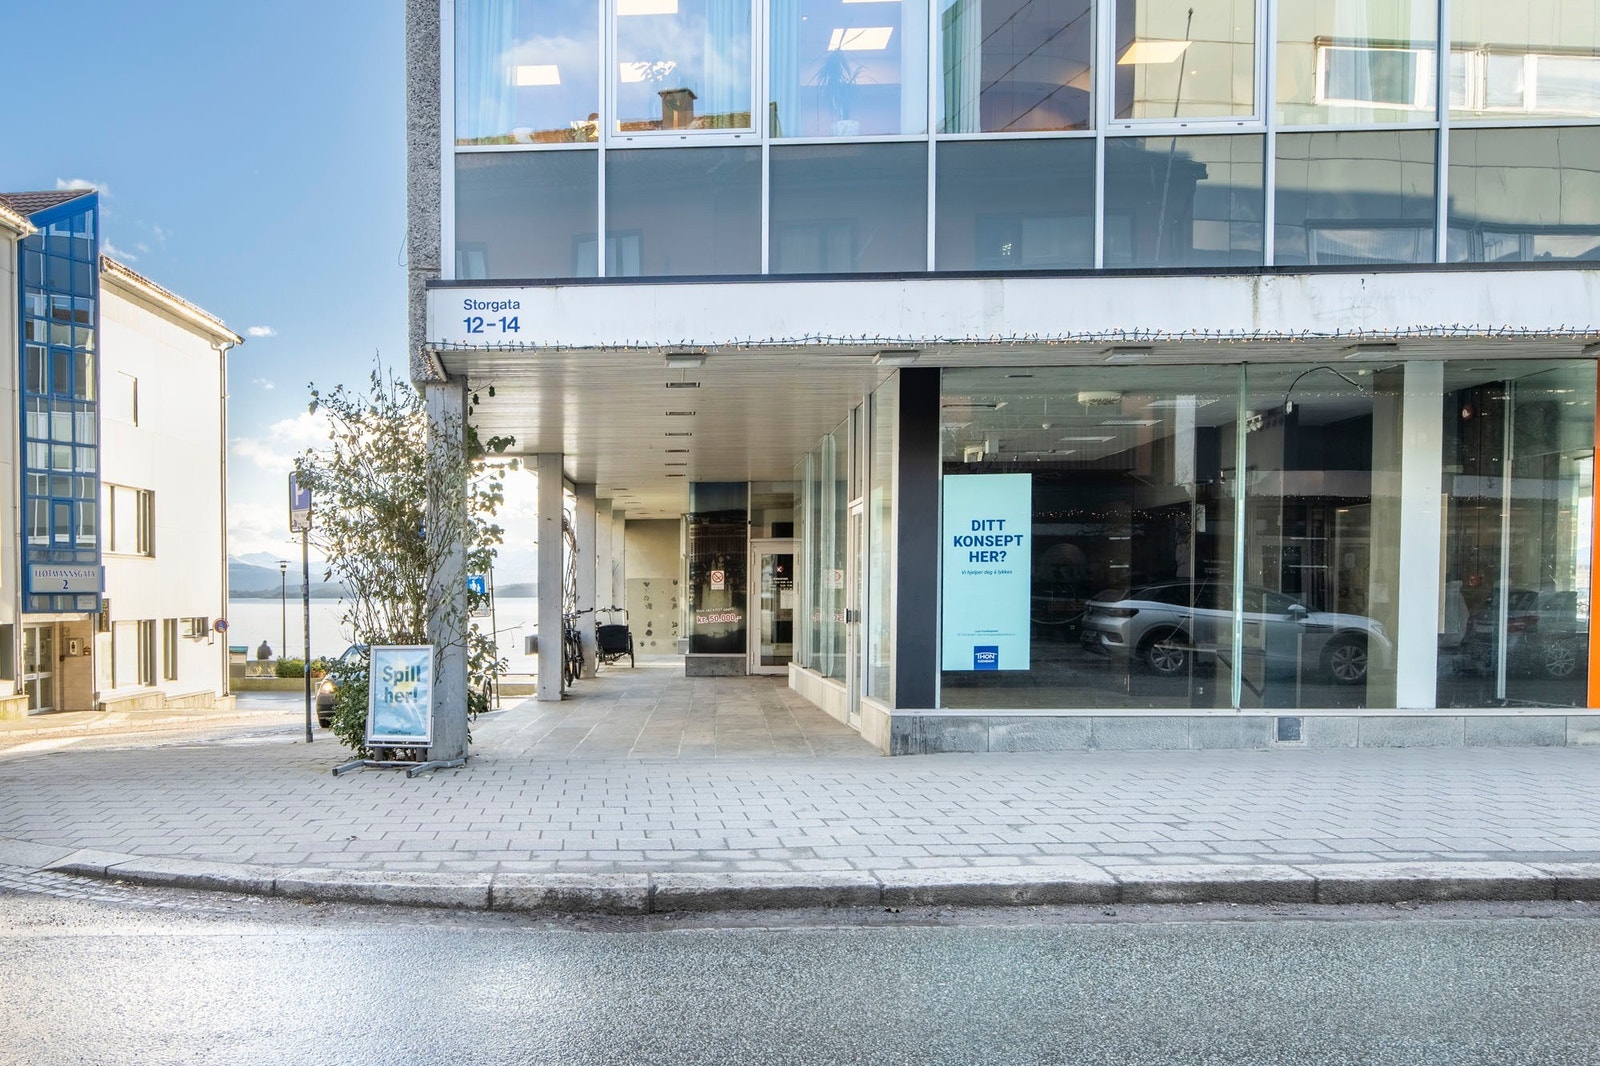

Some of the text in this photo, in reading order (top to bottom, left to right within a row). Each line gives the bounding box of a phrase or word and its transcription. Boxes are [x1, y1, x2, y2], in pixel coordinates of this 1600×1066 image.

[463, 298, 520, 313] Storgata
[463, 316, 520, 333] 12-14
[971, 519, 1006, 531] DITT
[953, 534, 1023, 547] KONSEPT
[969, 550, 1007, 563] HER?
[34, 569, 96, 578] FLØTMANNSGATA
[62, 579, 69, 590] 2
[975, 652, 997, 660] THON
[382, 665, 421, 686] Spill
[384, 686, 418, 704] her!
